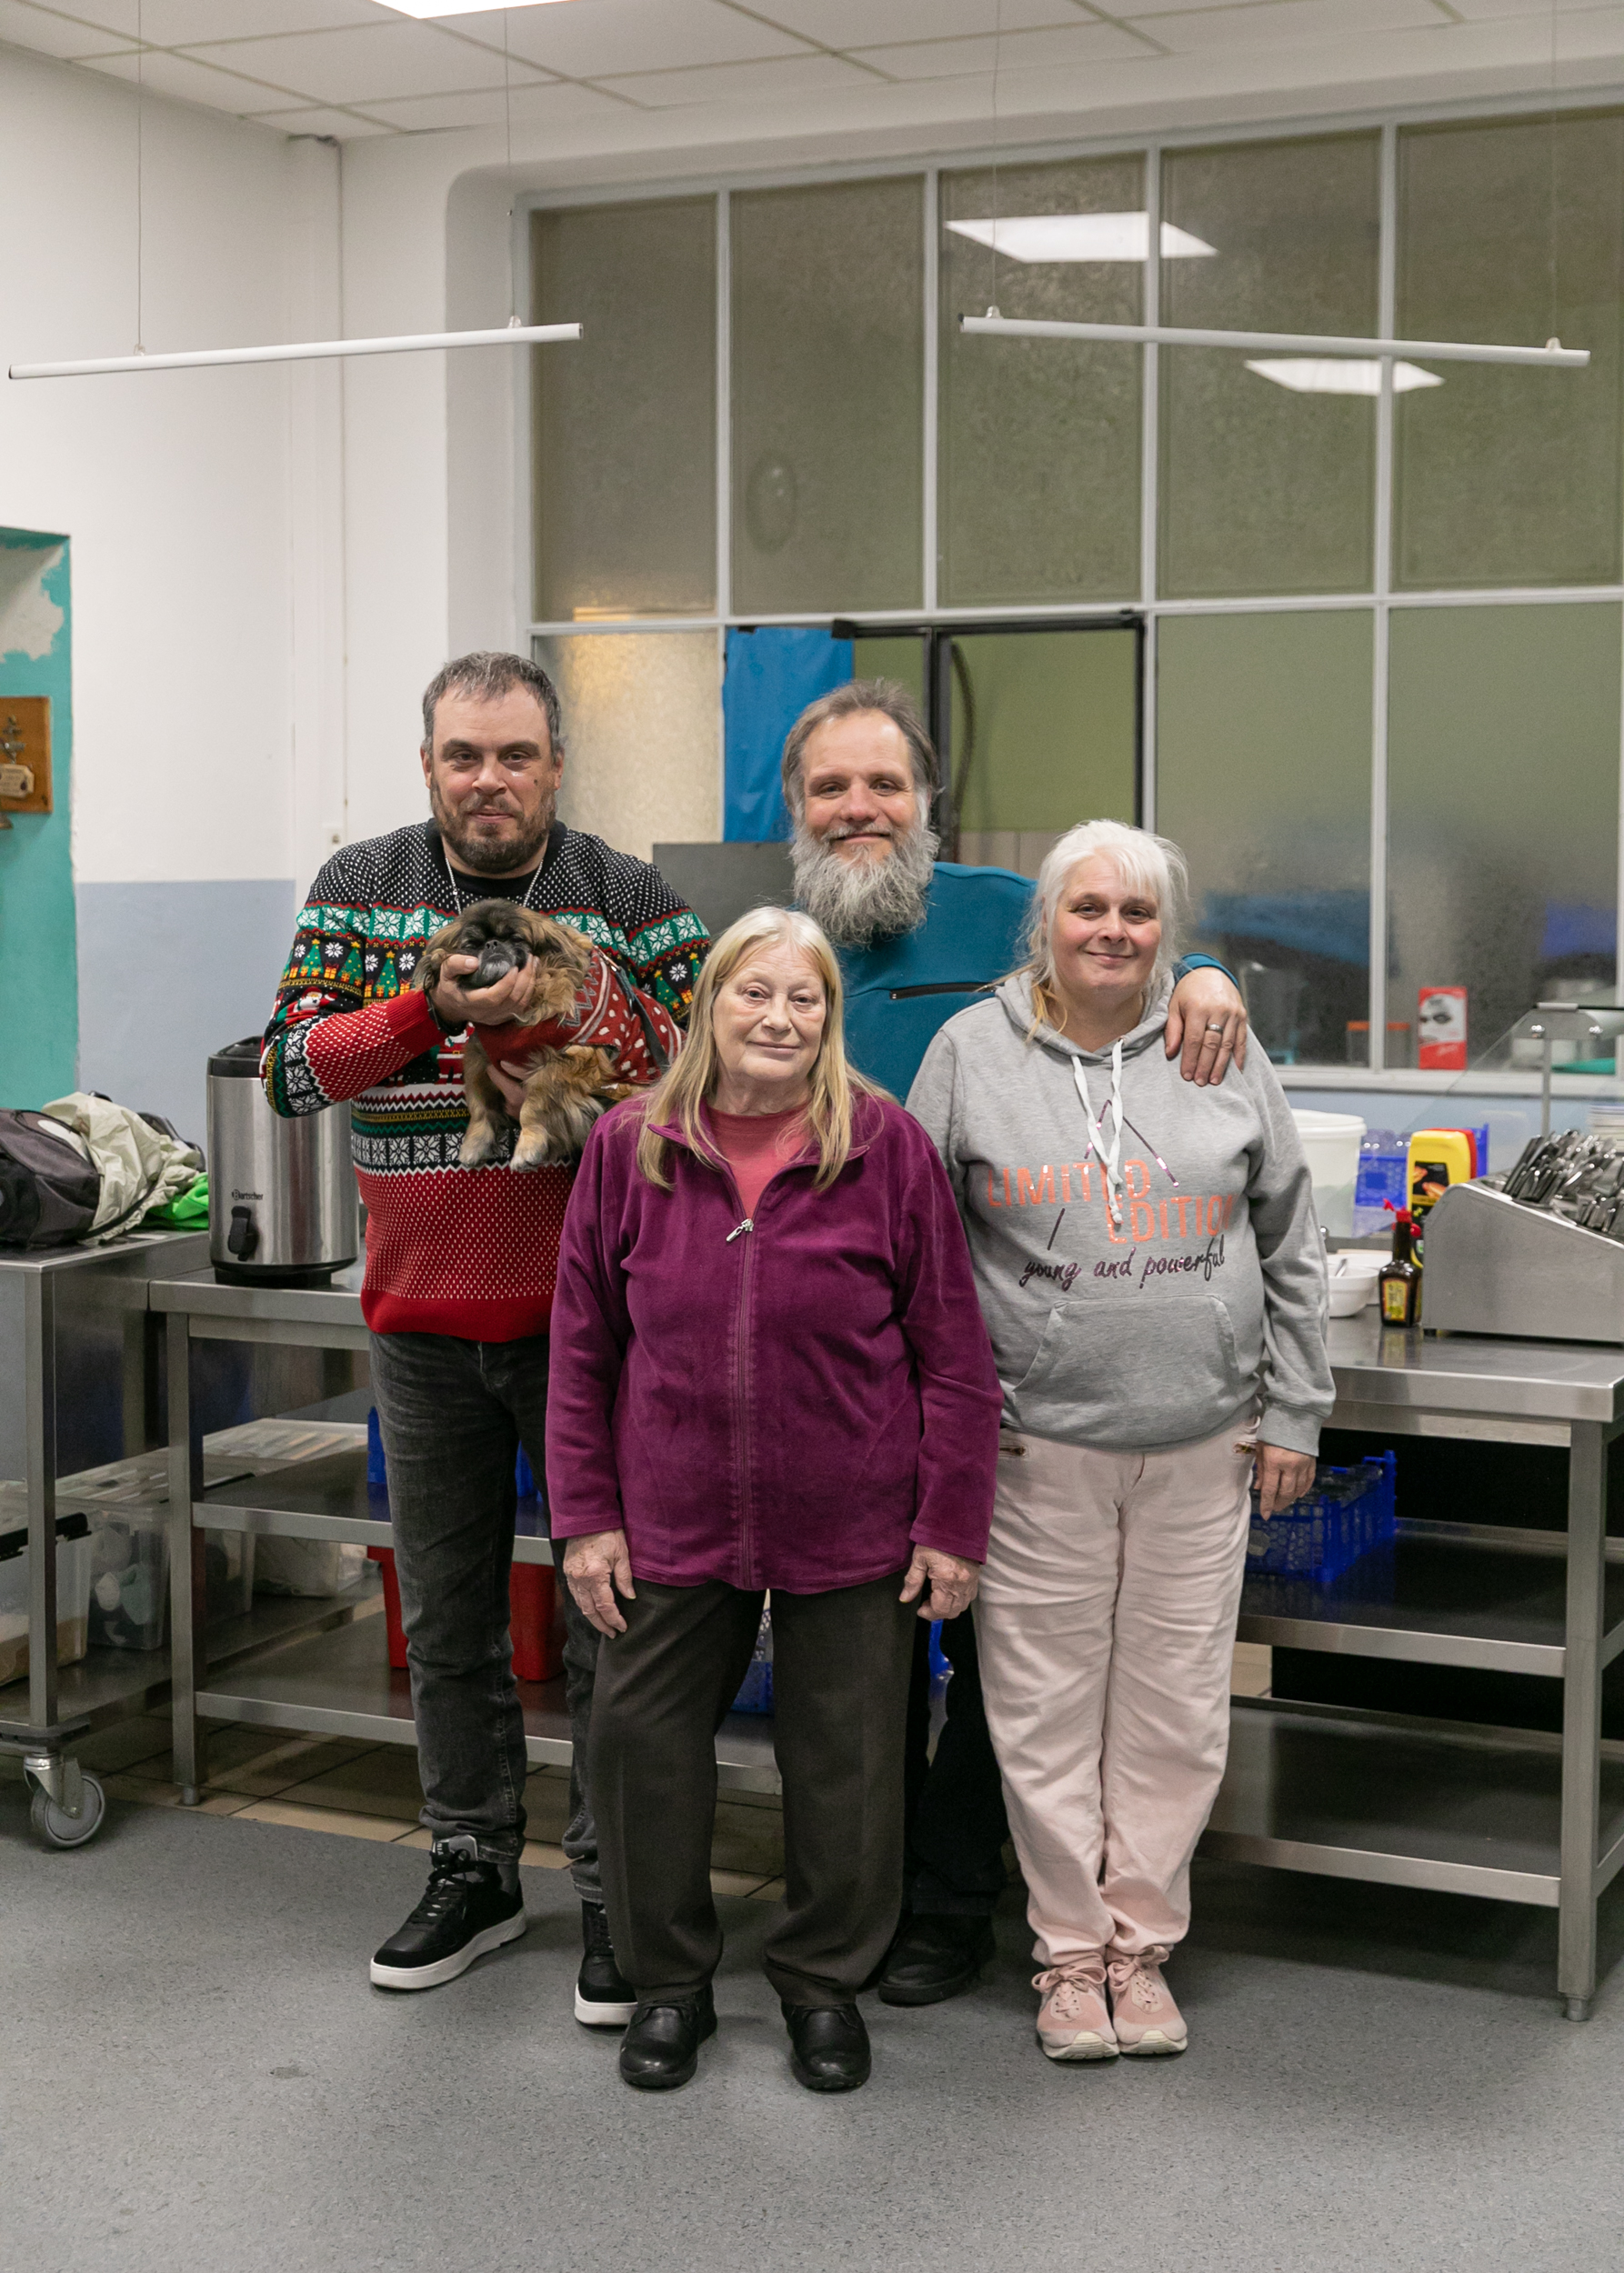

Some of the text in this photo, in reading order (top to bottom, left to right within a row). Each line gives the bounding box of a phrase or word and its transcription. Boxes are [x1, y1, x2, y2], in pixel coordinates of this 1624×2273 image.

[232, 1188, 264, 1201] Bartscher
[1018, 1234, 1226, 1292] young and powerful
